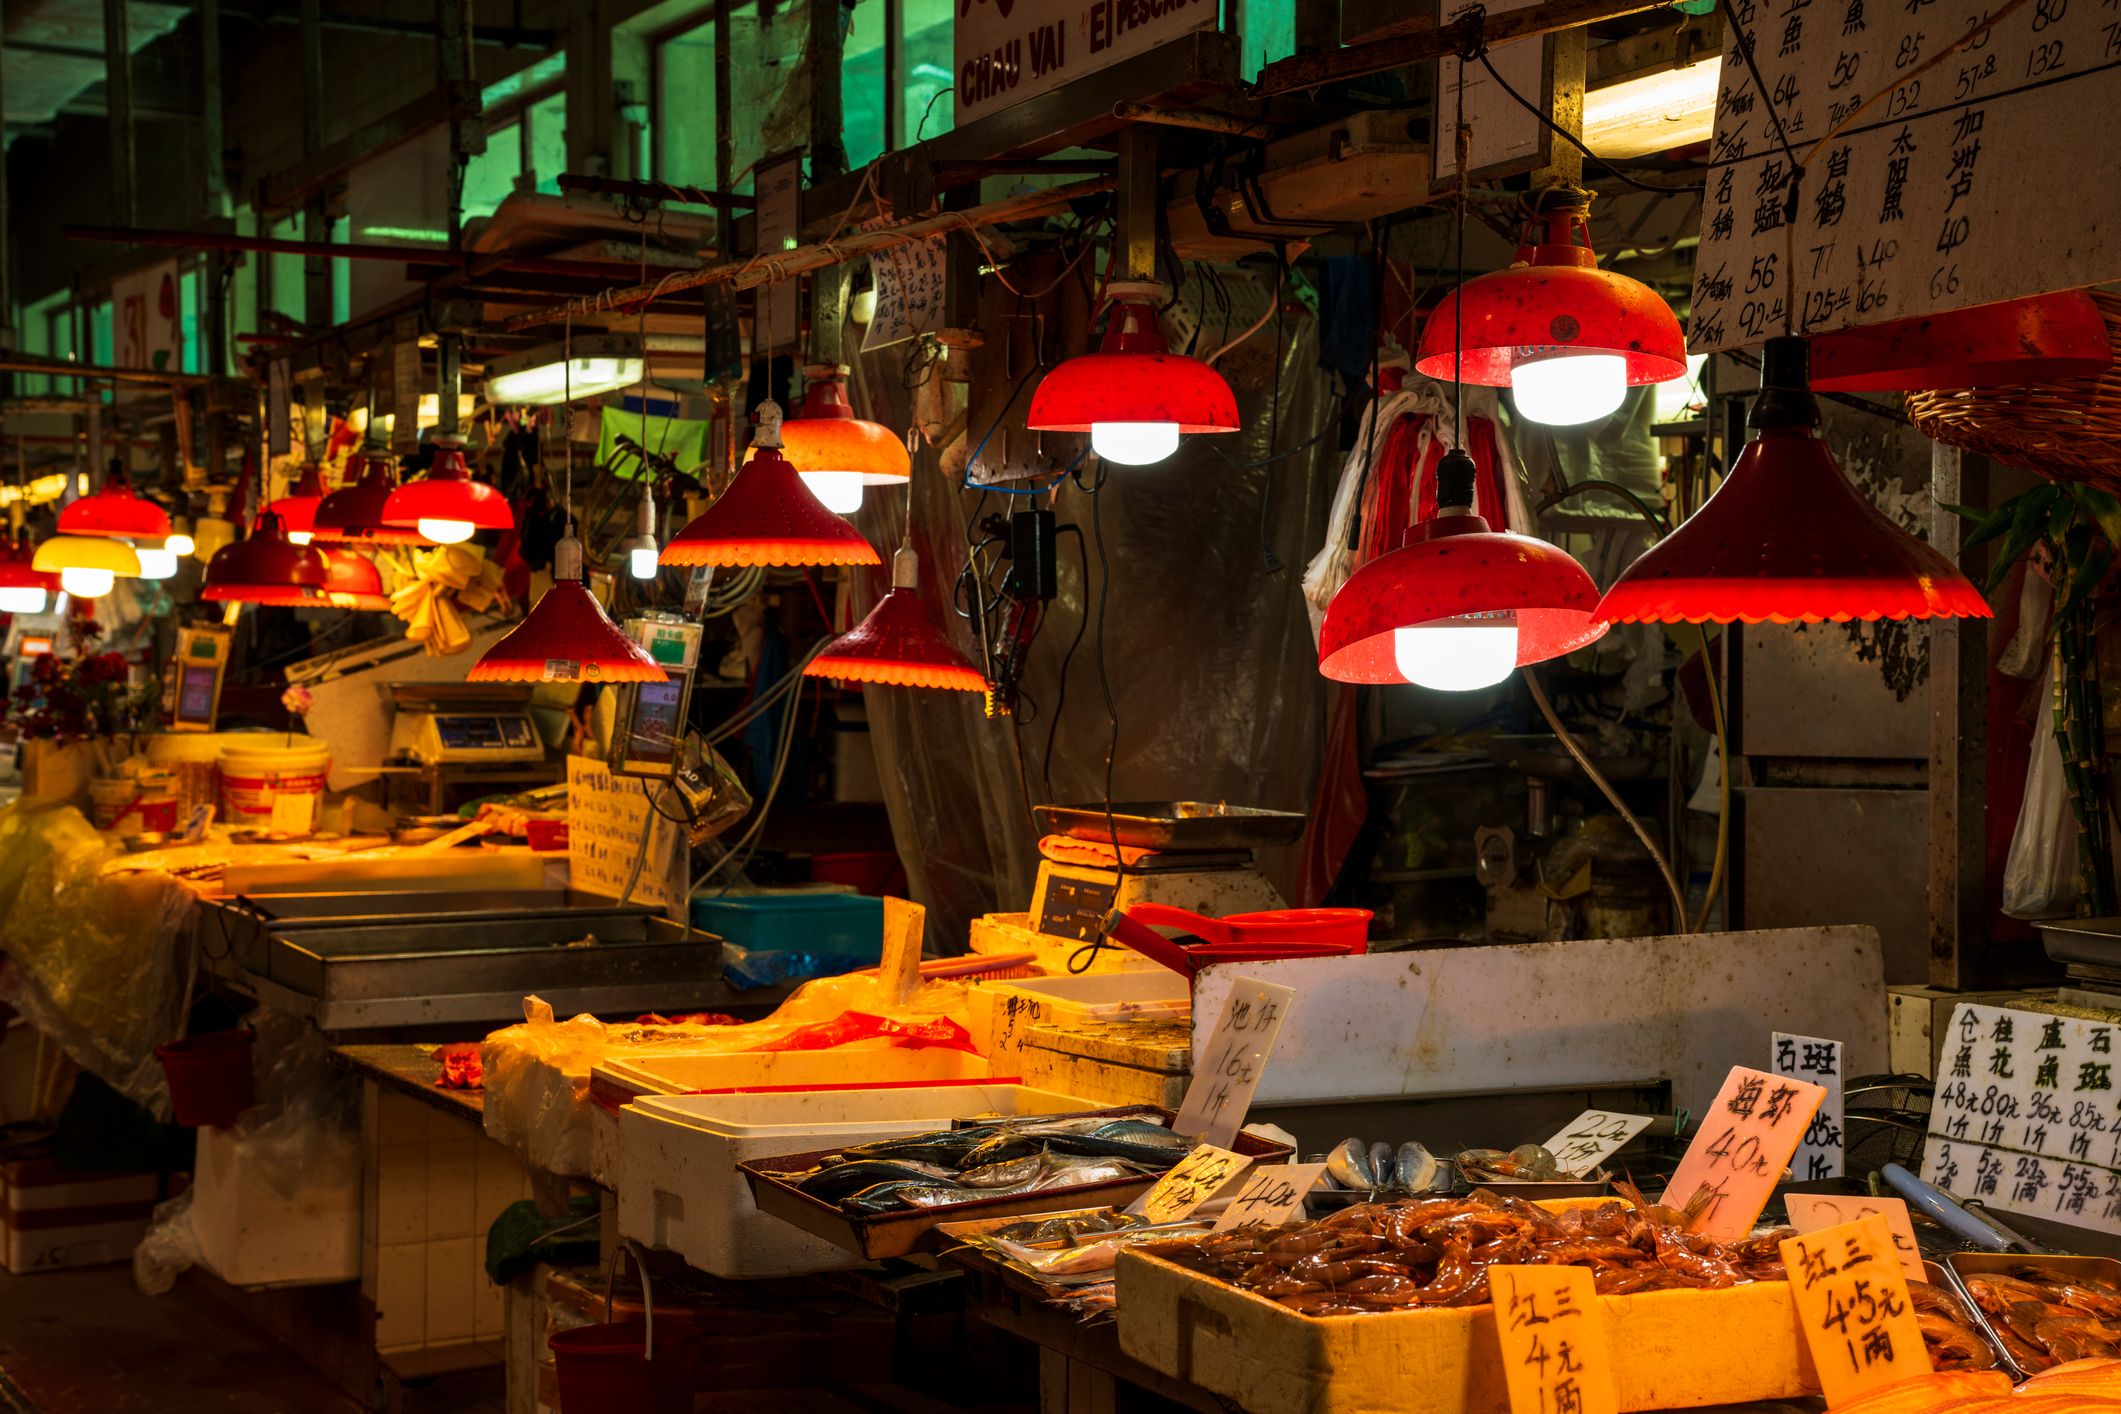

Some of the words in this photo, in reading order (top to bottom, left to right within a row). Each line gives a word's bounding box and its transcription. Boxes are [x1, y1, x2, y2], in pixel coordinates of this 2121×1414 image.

[961, 39, 1021, 107] CHAU
[1029, 20, 1064, 79] VAI
[1774, 74, 1799, 107] 64
[1828, 51, 1860, 90] 50
[1896, 32, 1925, 69] 85
[2032, 0, 2067, 32] 80
[1886, 80, 1921, 117] 132
[1954, 55, 1997, 100] 57.8
[2026, 40, 2065, 78] 132
[1745, 253, 1777, 293] 56
[1937, 216, 1969, 256] 40
[1739, 298, 1786, 337] 92.4
[1801, 287, 1852, 334] 125.4
[1930, 264, 1959, 300] 66
[1776, 1039, 1837, 1075] 石斑
[2073, 1027, 2112, 1092] 石斑
[1941, 1082, 1979, 1113] 48元
[1980, 1085, 2020, 1119] 80元
[2026, 1091, 2063, 1124] 36元
[2069, 1100, 2107, 1131] 85元
[1706, 1126, 1768, 1176] 40元
[1936, 1144, 1959, 1177] 3元
[1977, 1148, 2004, 1175] 5元
[1237, 1176, 1297, 1211] 40元
[1525, 1334, 1584, 1379] 4元
